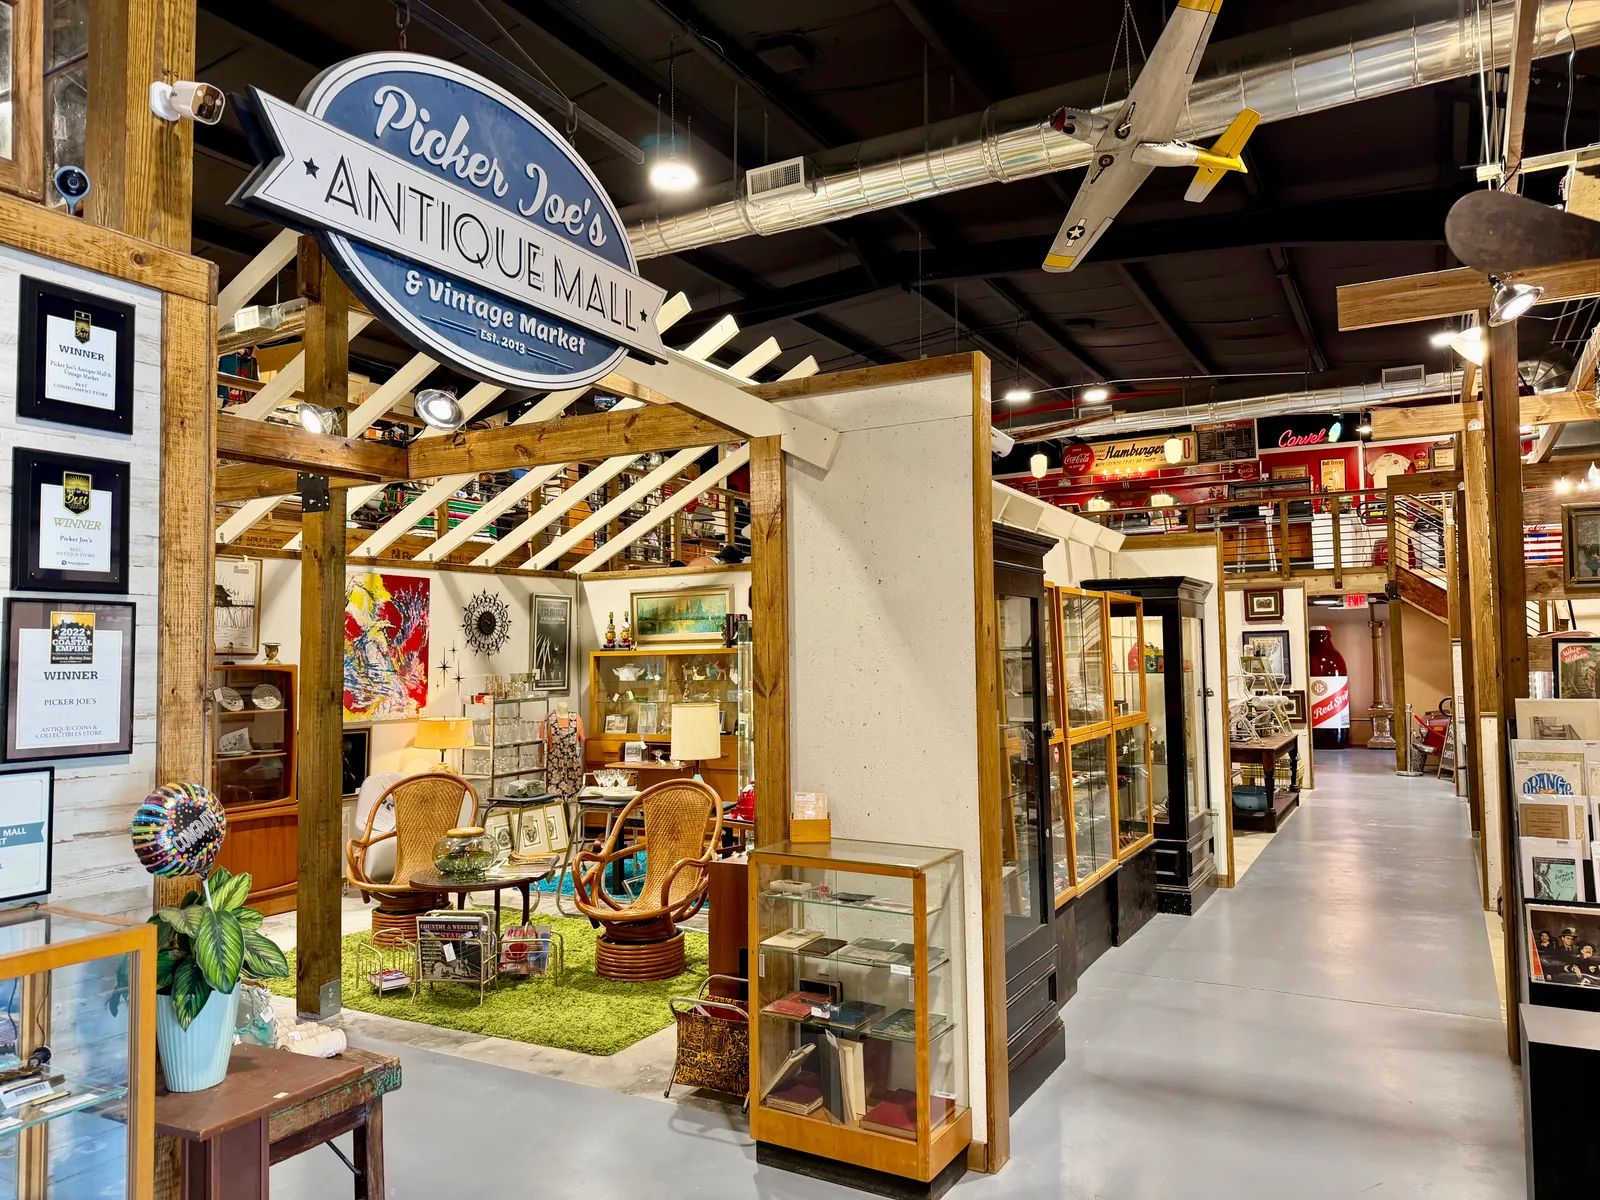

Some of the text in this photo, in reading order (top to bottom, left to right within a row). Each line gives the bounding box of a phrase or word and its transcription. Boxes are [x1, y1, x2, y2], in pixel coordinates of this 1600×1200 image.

[374, 85, 607, 247] Picker Joe's
[324, 154, 639, 332] ANTIQUE MALL
[405, 270, 586, 355] & Vintage Market
[480, 329, 526, 354] Est. 2013
[59, 344, 105, 361] WINNER
[50, 360, 65, 369] Picker
[66, 363, 77, 371] Joe's
[78, 365, 96, 375] Antique
[64, 369, 99, 381] Vintage Market
[53, 383, 92, 394] CONSIGNMENT
[1278, 428, 1327, 448] Carvel
[65, 491, 90, 506] Best
[53, 517, 102, 531] WINNER
[1346, 594, 1365, 608] EXIT
[60, 628, 86, 636] 2022
[44, 671, 98, 680] WINNER
[44, 697, 97, 706] PICKER JOE'S
[1313, 700, 1334, 719] Red
[35, 731, 82, 739] COLLECTIBLES
[41, 725, 92, 733] ANTIQUE/COINS
[3, 827, 27, 837] MALL
